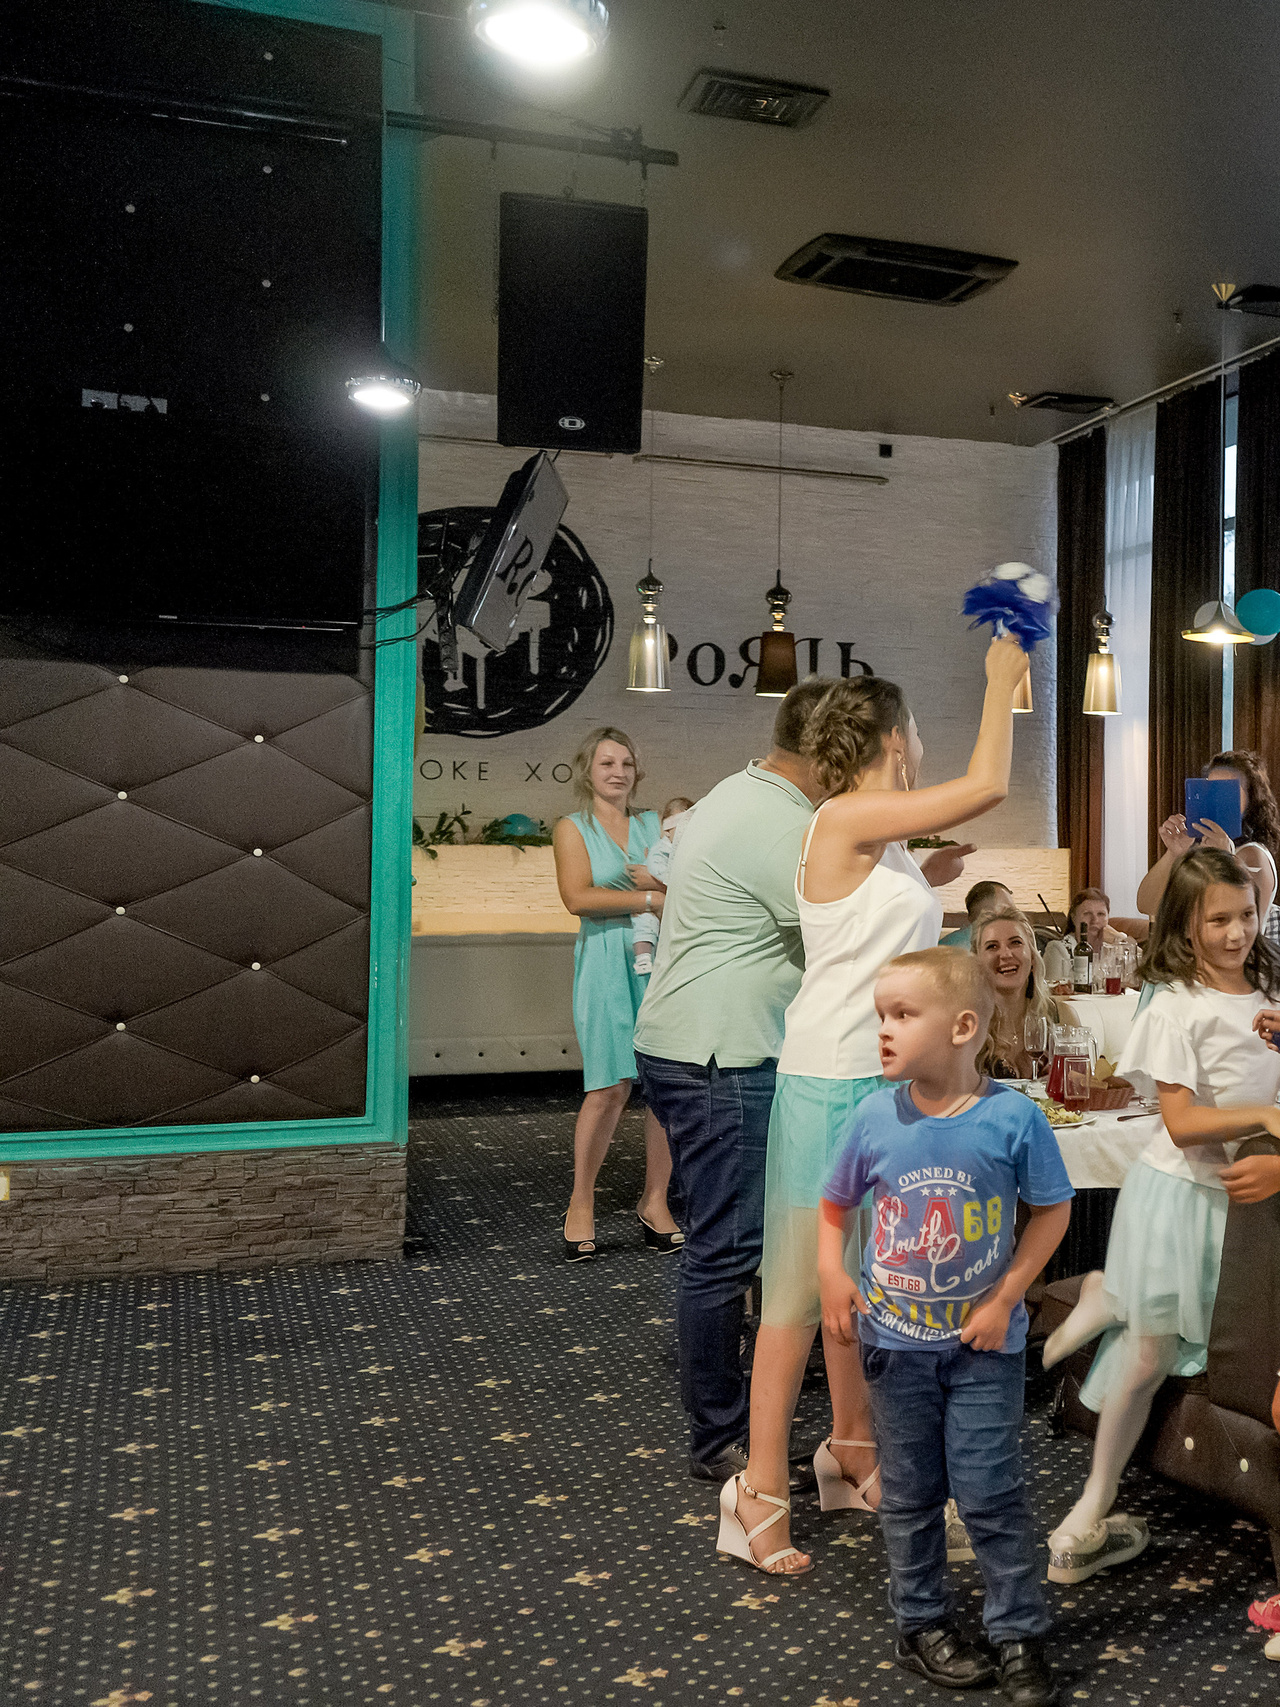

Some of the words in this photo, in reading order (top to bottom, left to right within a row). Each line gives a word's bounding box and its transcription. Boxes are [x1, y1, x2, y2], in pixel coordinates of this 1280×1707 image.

[898, 1167, 954, 1187] OWNED
[956, 1170, 977, 1186] BY
[875, 1195, 946, 1262] South
[963, 1196, 1002, 1242] 68
[887, 1273, 921, 1292] EST.68
[927, 1233, 1000, 1293] Coast
